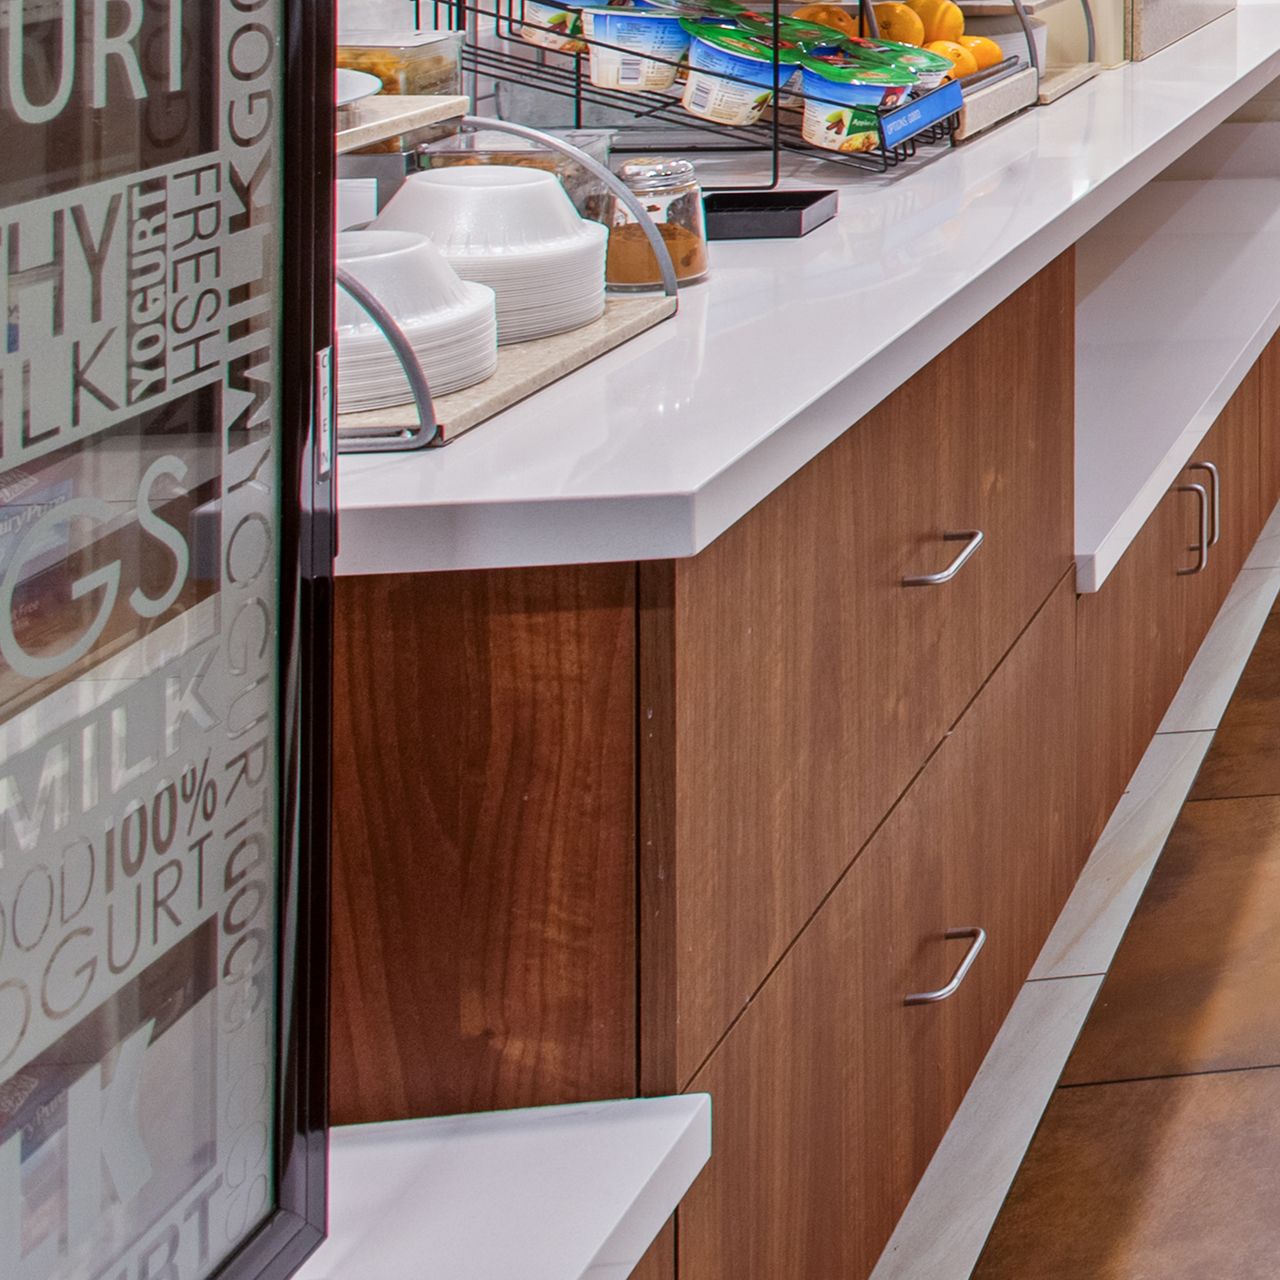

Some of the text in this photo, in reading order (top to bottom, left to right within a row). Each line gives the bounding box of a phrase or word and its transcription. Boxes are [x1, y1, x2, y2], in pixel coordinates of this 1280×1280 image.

[0, 192, 124, 338] HY
[130, 185, 168, 403] YOGURT
[172, 162, 222, 385] FRESH
[227, 142, 272, 456] MILK
[0, 326, 121, 450] LK
[0, 747, 218, 952] OD 100%
